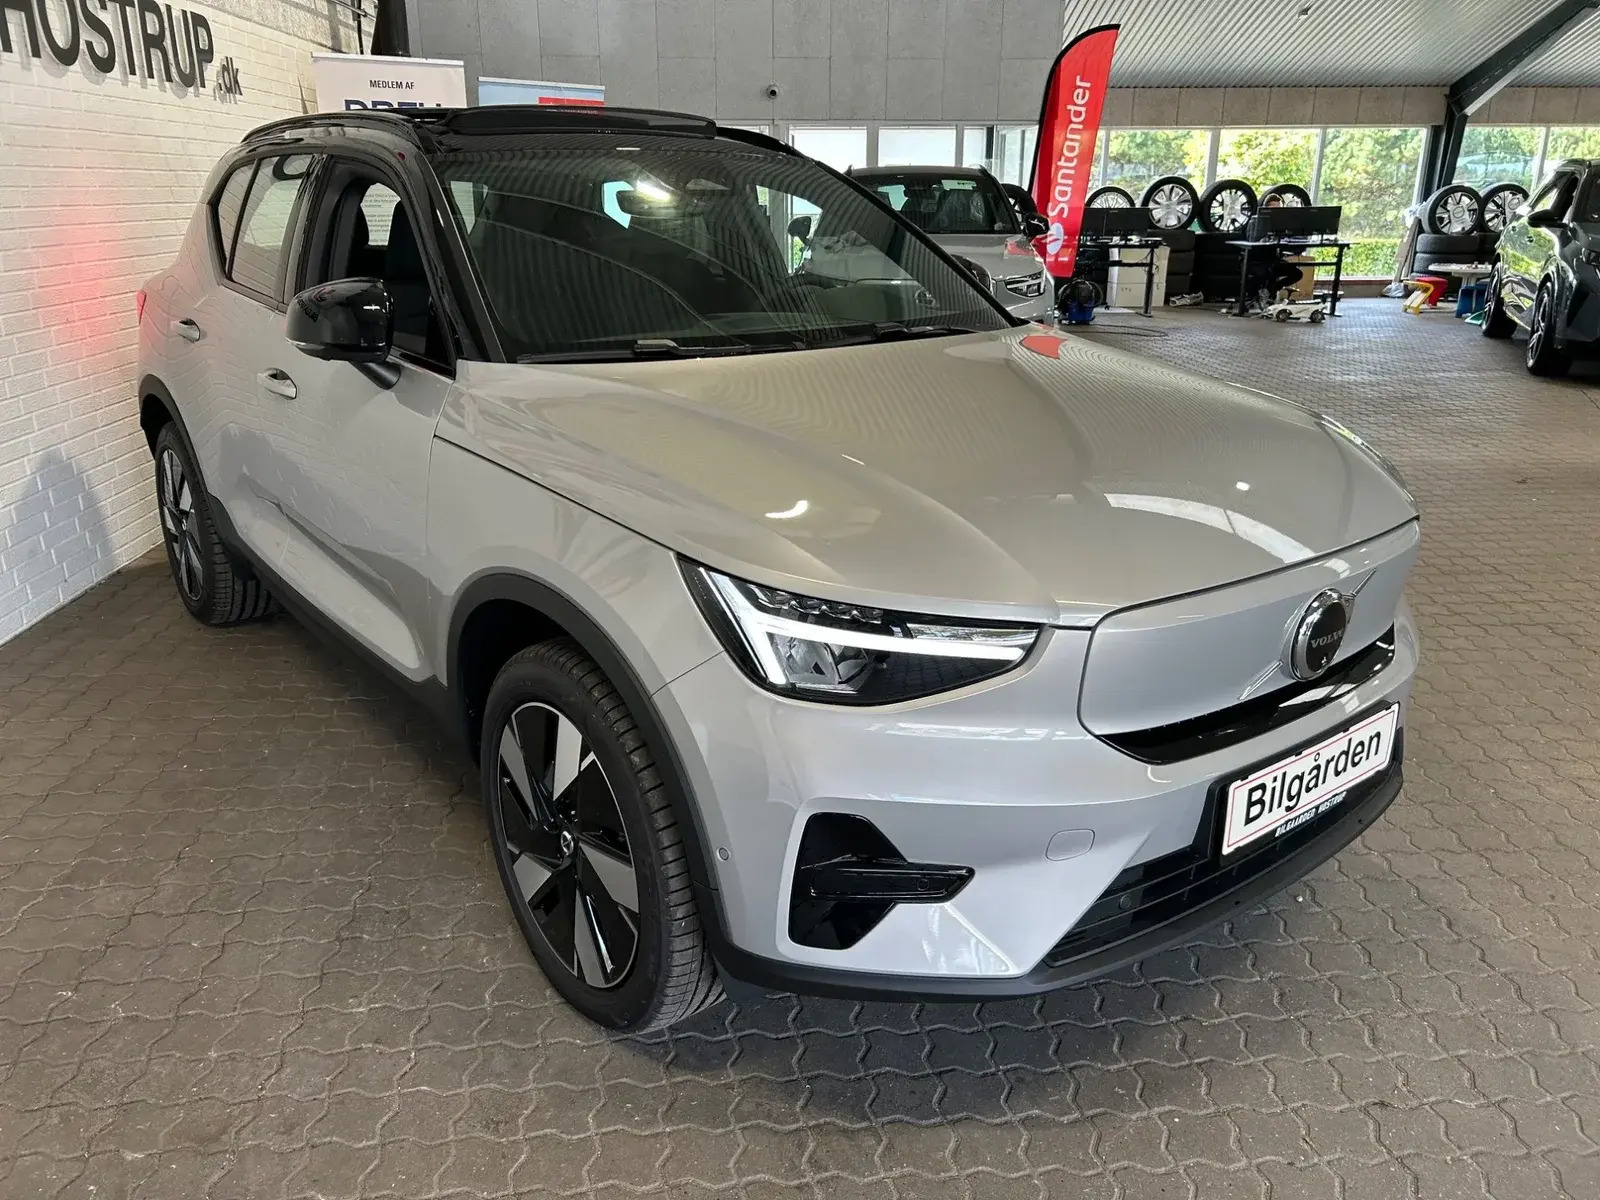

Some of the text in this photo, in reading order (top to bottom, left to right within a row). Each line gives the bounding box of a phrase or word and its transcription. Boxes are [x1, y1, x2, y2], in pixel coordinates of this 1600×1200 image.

[369, 80, 415, 90] MEDLEM AF
[1047, 75, 1091, 218] Santander
[1244, 731, 1381, 827] Bilgården
